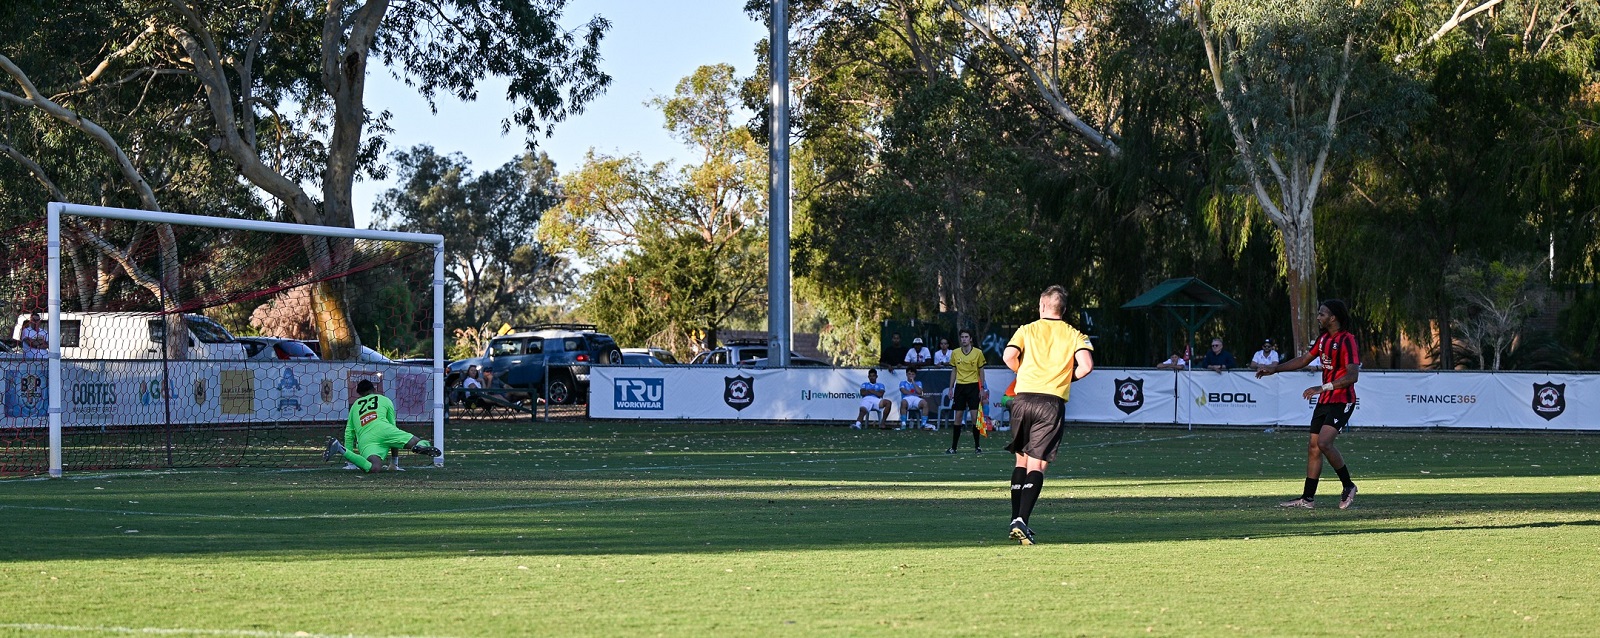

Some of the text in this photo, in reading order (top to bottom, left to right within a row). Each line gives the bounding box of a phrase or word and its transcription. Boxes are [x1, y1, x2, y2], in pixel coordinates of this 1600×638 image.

[72, 383, 117, 405] CORTES
[1208, 393, 1257, 403] BOOL
[357, 395, 379, 416] 23
[616, 401, 662, 409] WORKWEAR
